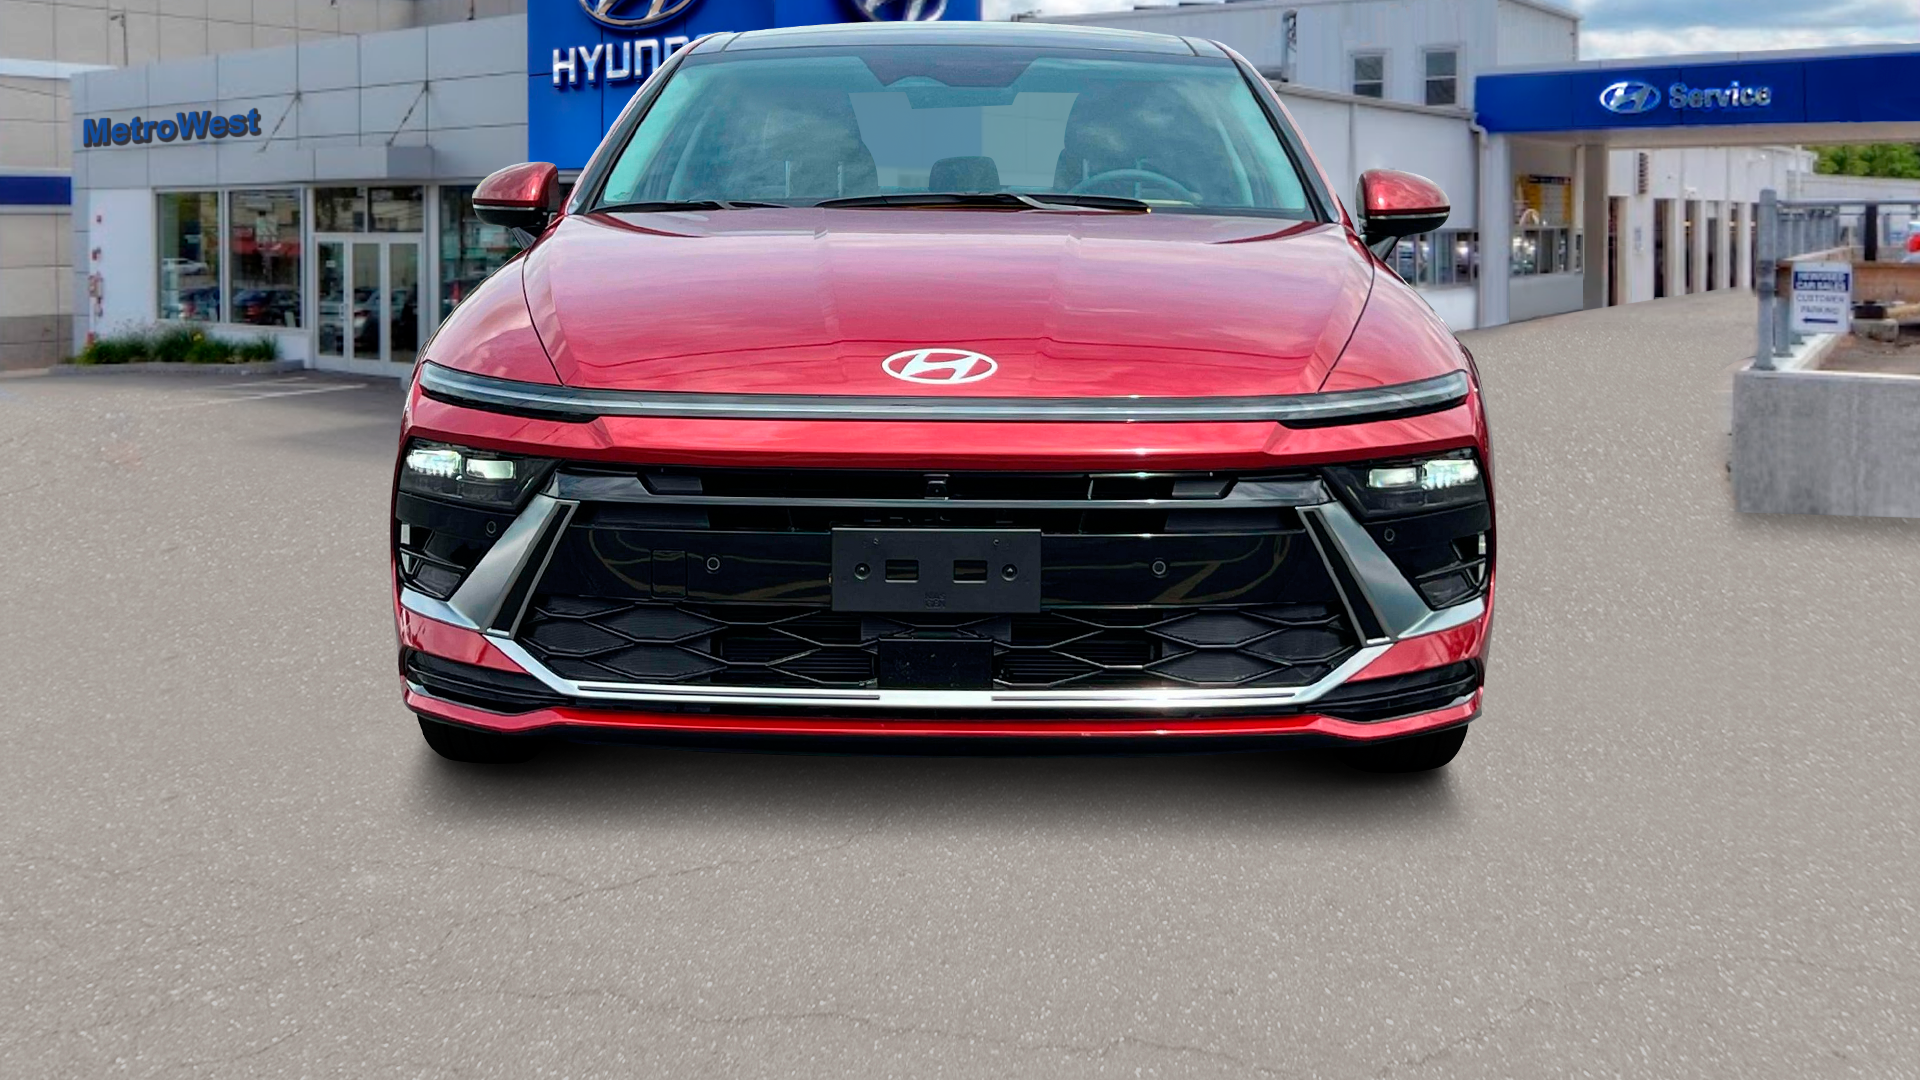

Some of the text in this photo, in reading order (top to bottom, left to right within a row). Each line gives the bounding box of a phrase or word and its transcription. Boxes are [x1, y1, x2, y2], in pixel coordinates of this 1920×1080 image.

[1669, 81, 1772, 109] Service
[83, 108, 261, 147] MetroWest
[1796, 293, 1845, 303] CUSTOMER
[1800, 305, 1840, 315] PARKING
